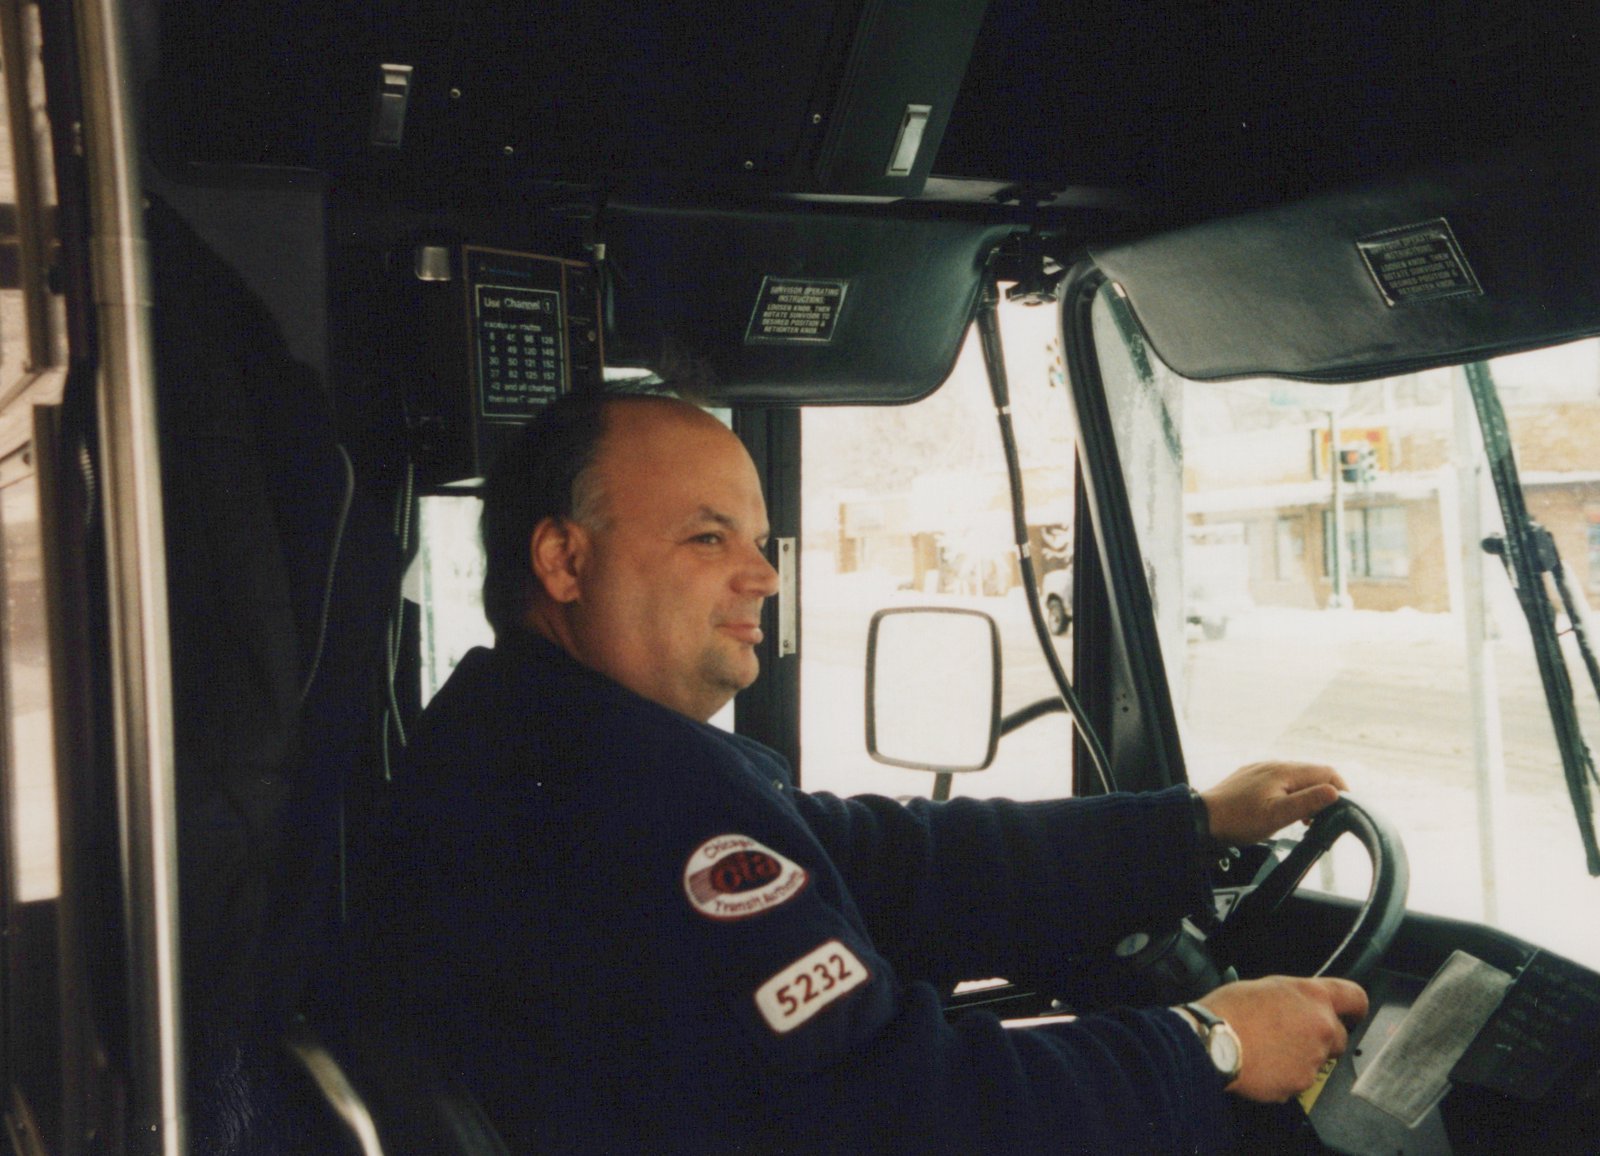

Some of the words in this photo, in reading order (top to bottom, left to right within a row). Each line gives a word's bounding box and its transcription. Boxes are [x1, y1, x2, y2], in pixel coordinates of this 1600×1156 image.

[483, 297, 501, 309] Use
[504, 297, 541, 311] Channel
[715, 896, 761, 913] Transit
[775, 953, 853, 1018] 5232
